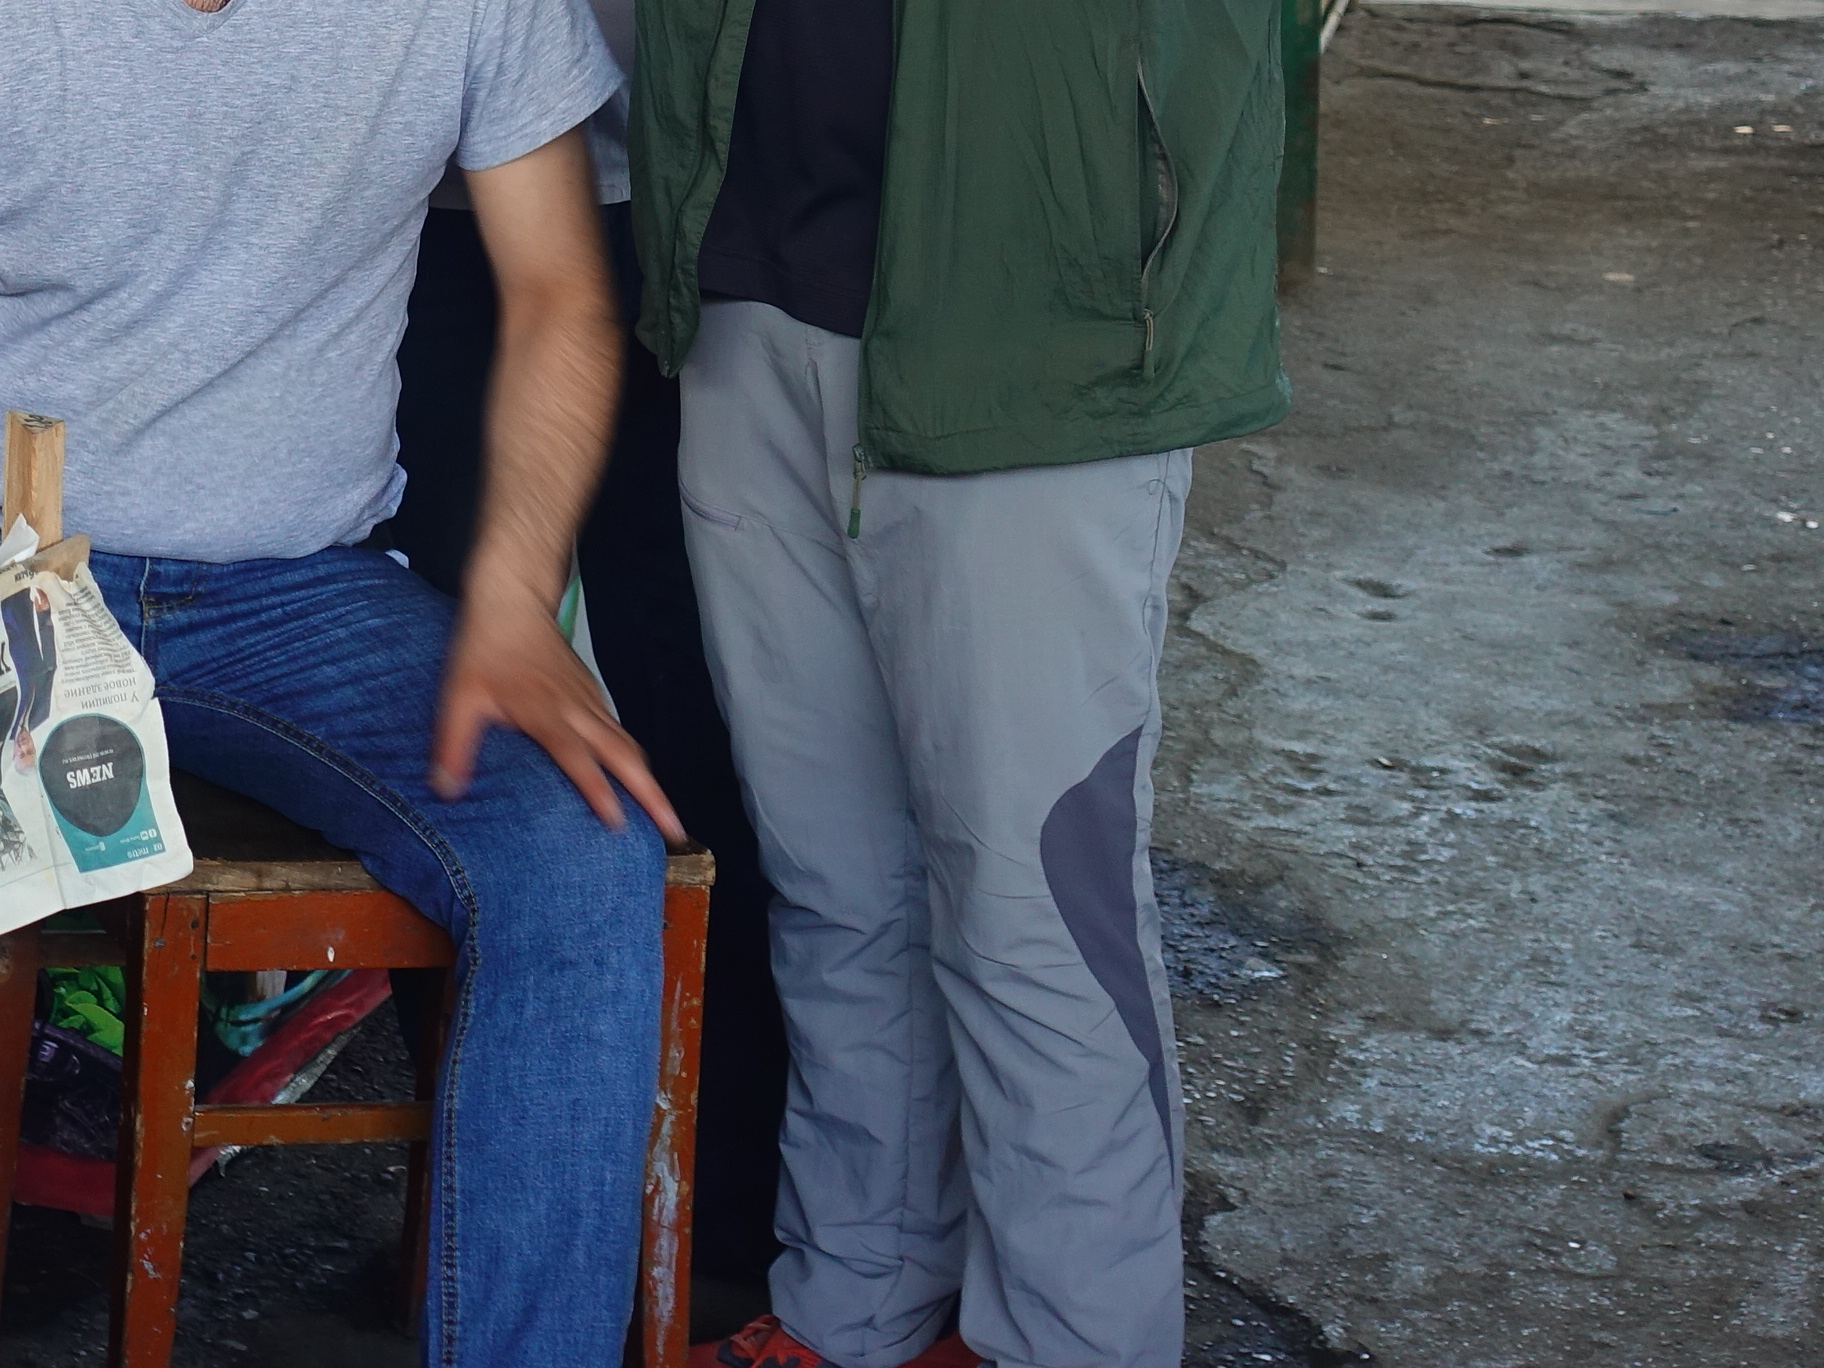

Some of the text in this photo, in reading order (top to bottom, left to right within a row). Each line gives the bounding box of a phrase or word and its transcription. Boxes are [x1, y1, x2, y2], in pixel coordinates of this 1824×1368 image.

[64, 677, 136, 700] новое здание
[80, 692, 127, 710] полиции
[66, 762, 115, 789] NEWS
